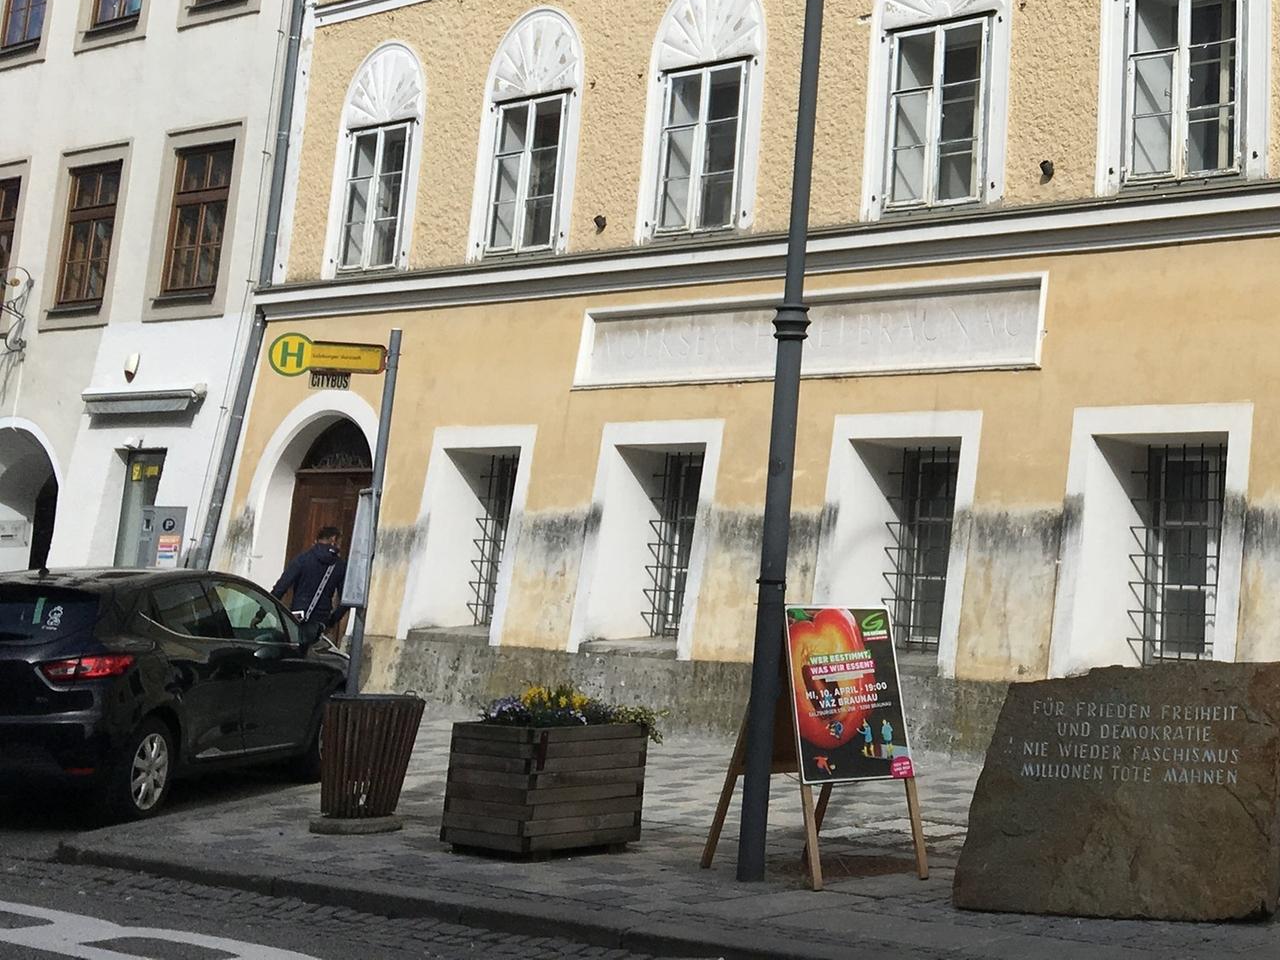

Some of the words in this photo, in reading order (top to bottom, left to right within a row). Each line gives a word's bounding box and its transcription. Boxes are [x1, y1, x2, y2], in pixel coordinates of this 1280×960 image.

[280, 341, 305, 368] H
[810, 656, 829, 664] WER
[810, 666, 829, 674] WAS
[830, 664, 845, 672] WIR
[846, 660, 874, 670] ESSEN?
[834, 686, 859, 697] APRIL
[864, 682, 887, 692] 19:00
[819, 699, 837, 709] VAZ
[838, 693, 878, 706] BRAUNAU
[1033, 697, 1065, 716] FÜR
[1076, 702, 1150, 718] FRIEDEN
[1161, 704, 1238, 721] FREIHEIT
[1057, 722, 1090, 737] UND
[1100, 724, 1212, 742] DEMOKRATIE
[1023, 741, 1049, 756] NIE
[1058, 743, 1121, 760] WIEDER
[1133, 745, 1239, 764] FASCHISMUS
[1020, 762, 1103, 780] MILLIONEN
[1112, 765, 1152, 782] TOTE
[1163, 768, 1237, 784] MAHNEN
